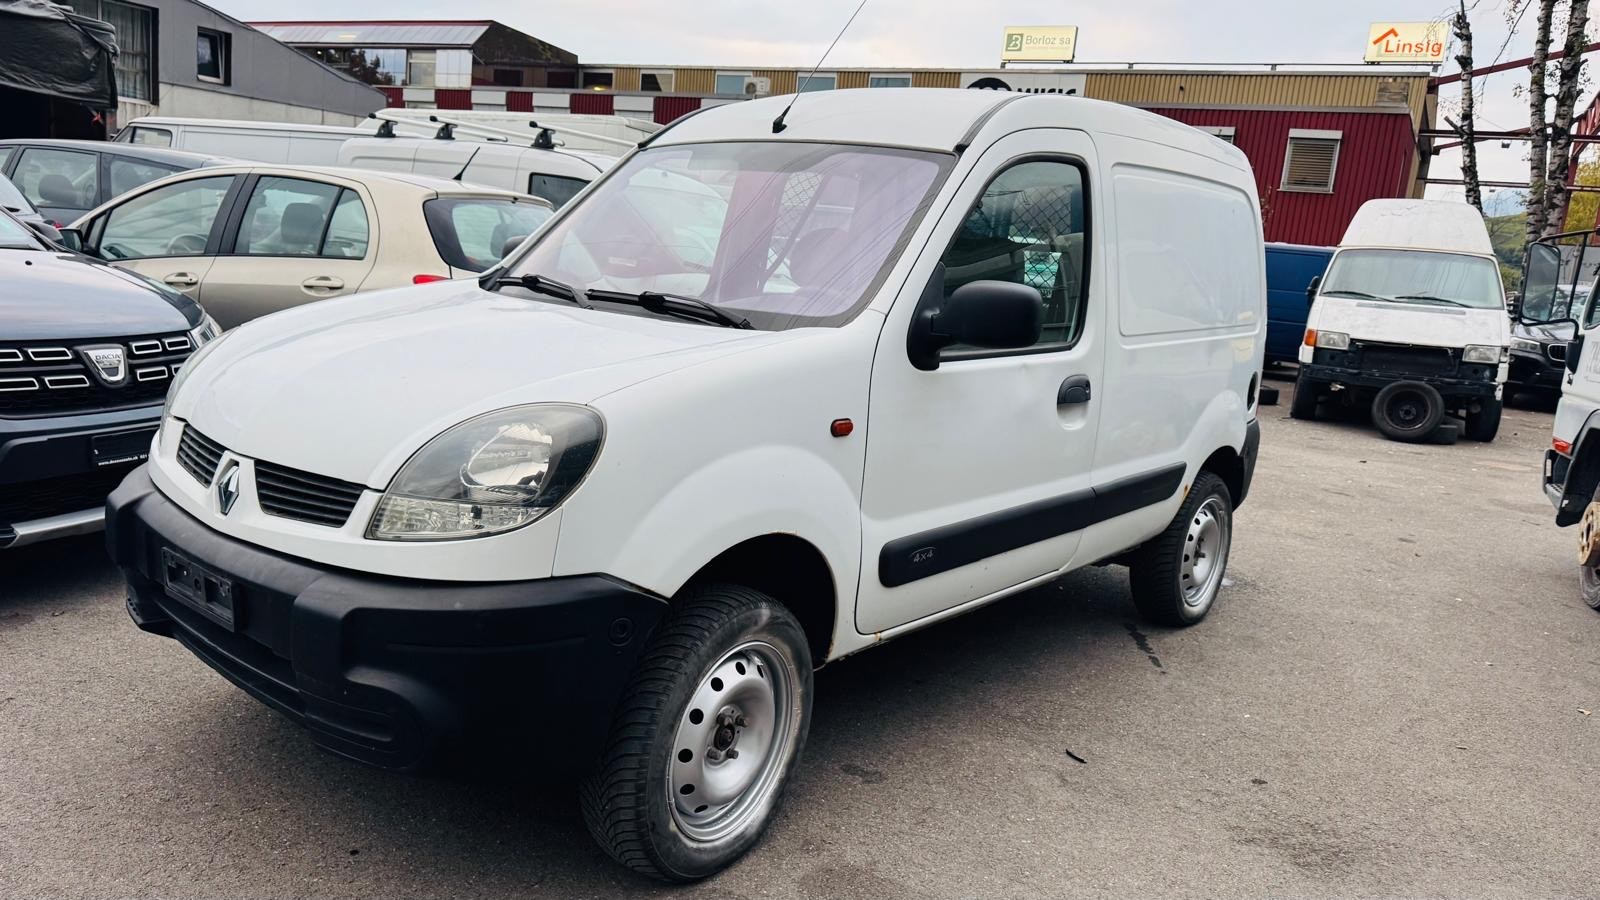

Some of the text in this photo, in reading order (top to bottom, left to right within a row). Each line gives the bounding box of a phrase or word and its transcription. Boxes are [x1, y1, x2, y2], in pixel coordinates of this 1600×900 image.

[1025, 35, 1071, 45] Borloz sa
[1384, 40, 1443, 57] Linsig
[913, 549, 934, 563] 4x4
